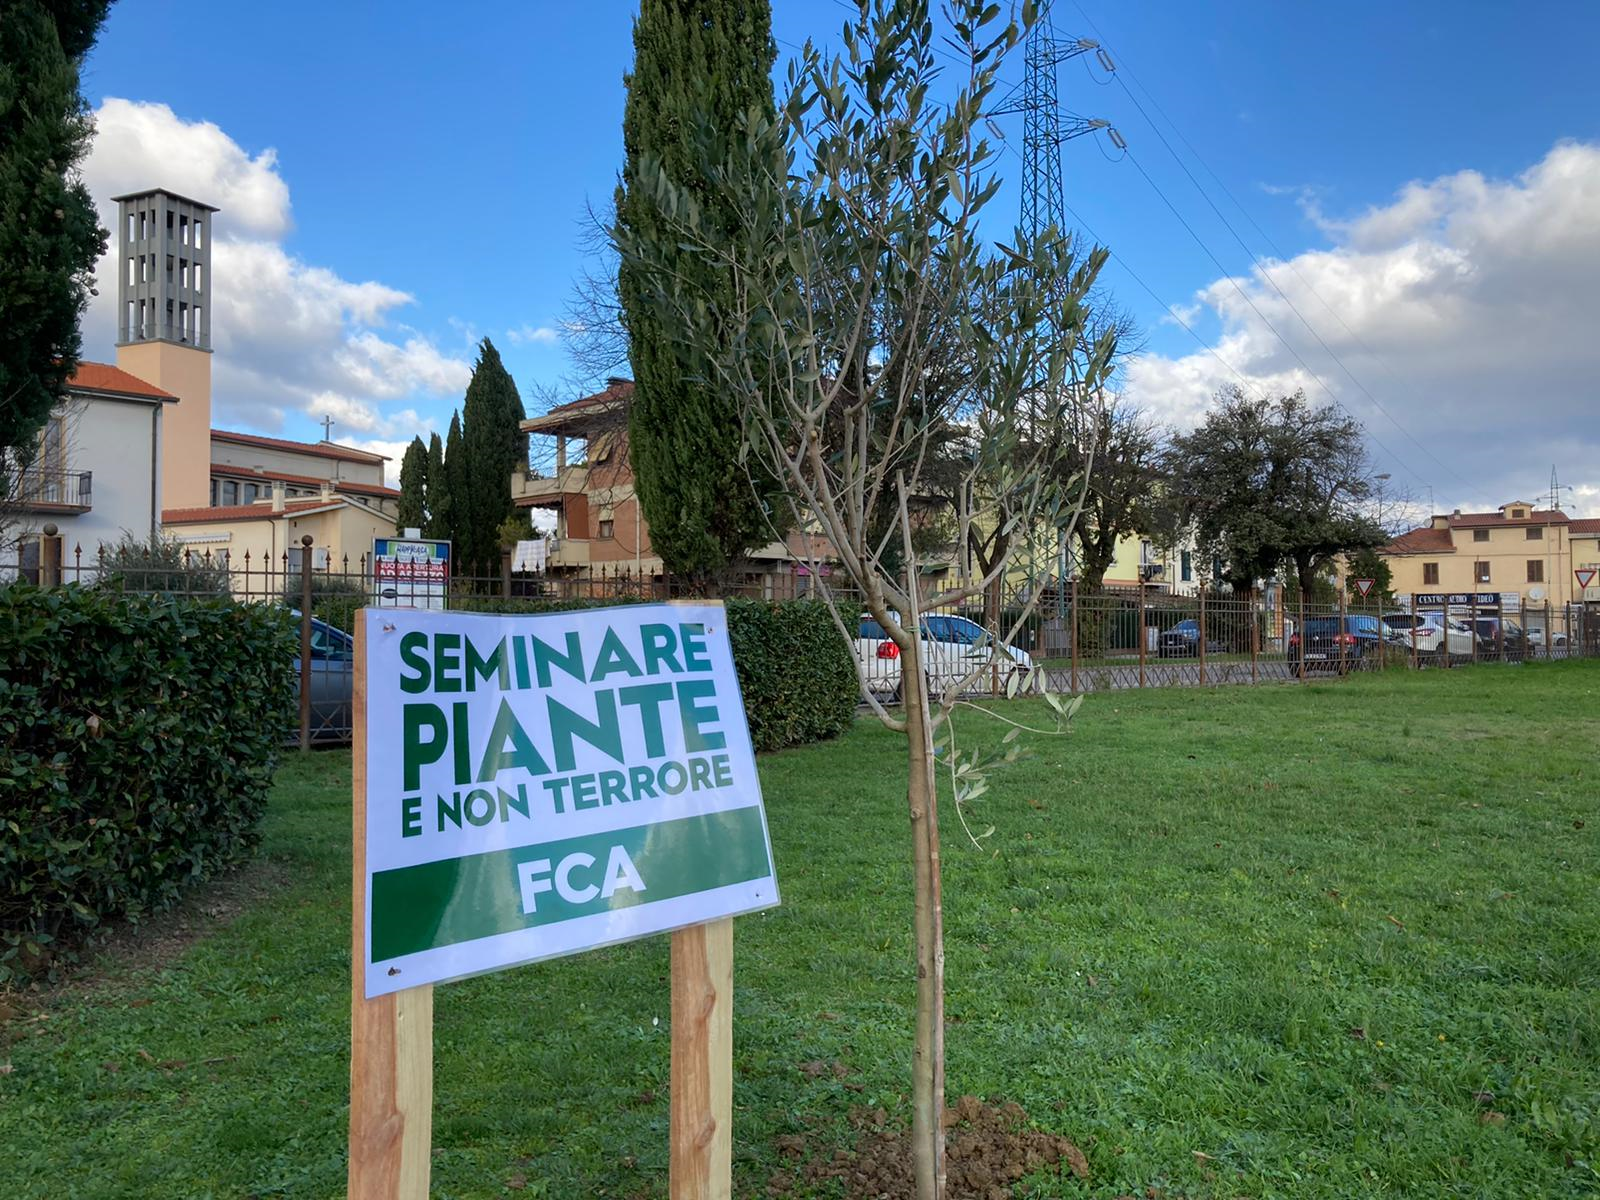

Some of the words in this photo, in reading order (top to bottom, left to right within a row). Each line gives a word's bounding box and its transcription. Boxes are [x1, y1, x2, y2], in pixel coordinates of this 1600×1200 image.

[1476, 595, 1494, 604] IDEO
[400, 623, 713, 694] SEMINARE
[403, 680, 728, 791] PIANTE
[402, 797, 422, 838] E
[438, 784, 531, 832] NON
[543, 754, 734, 814] TERRORE
[517, 845, 647, 914] FCA
